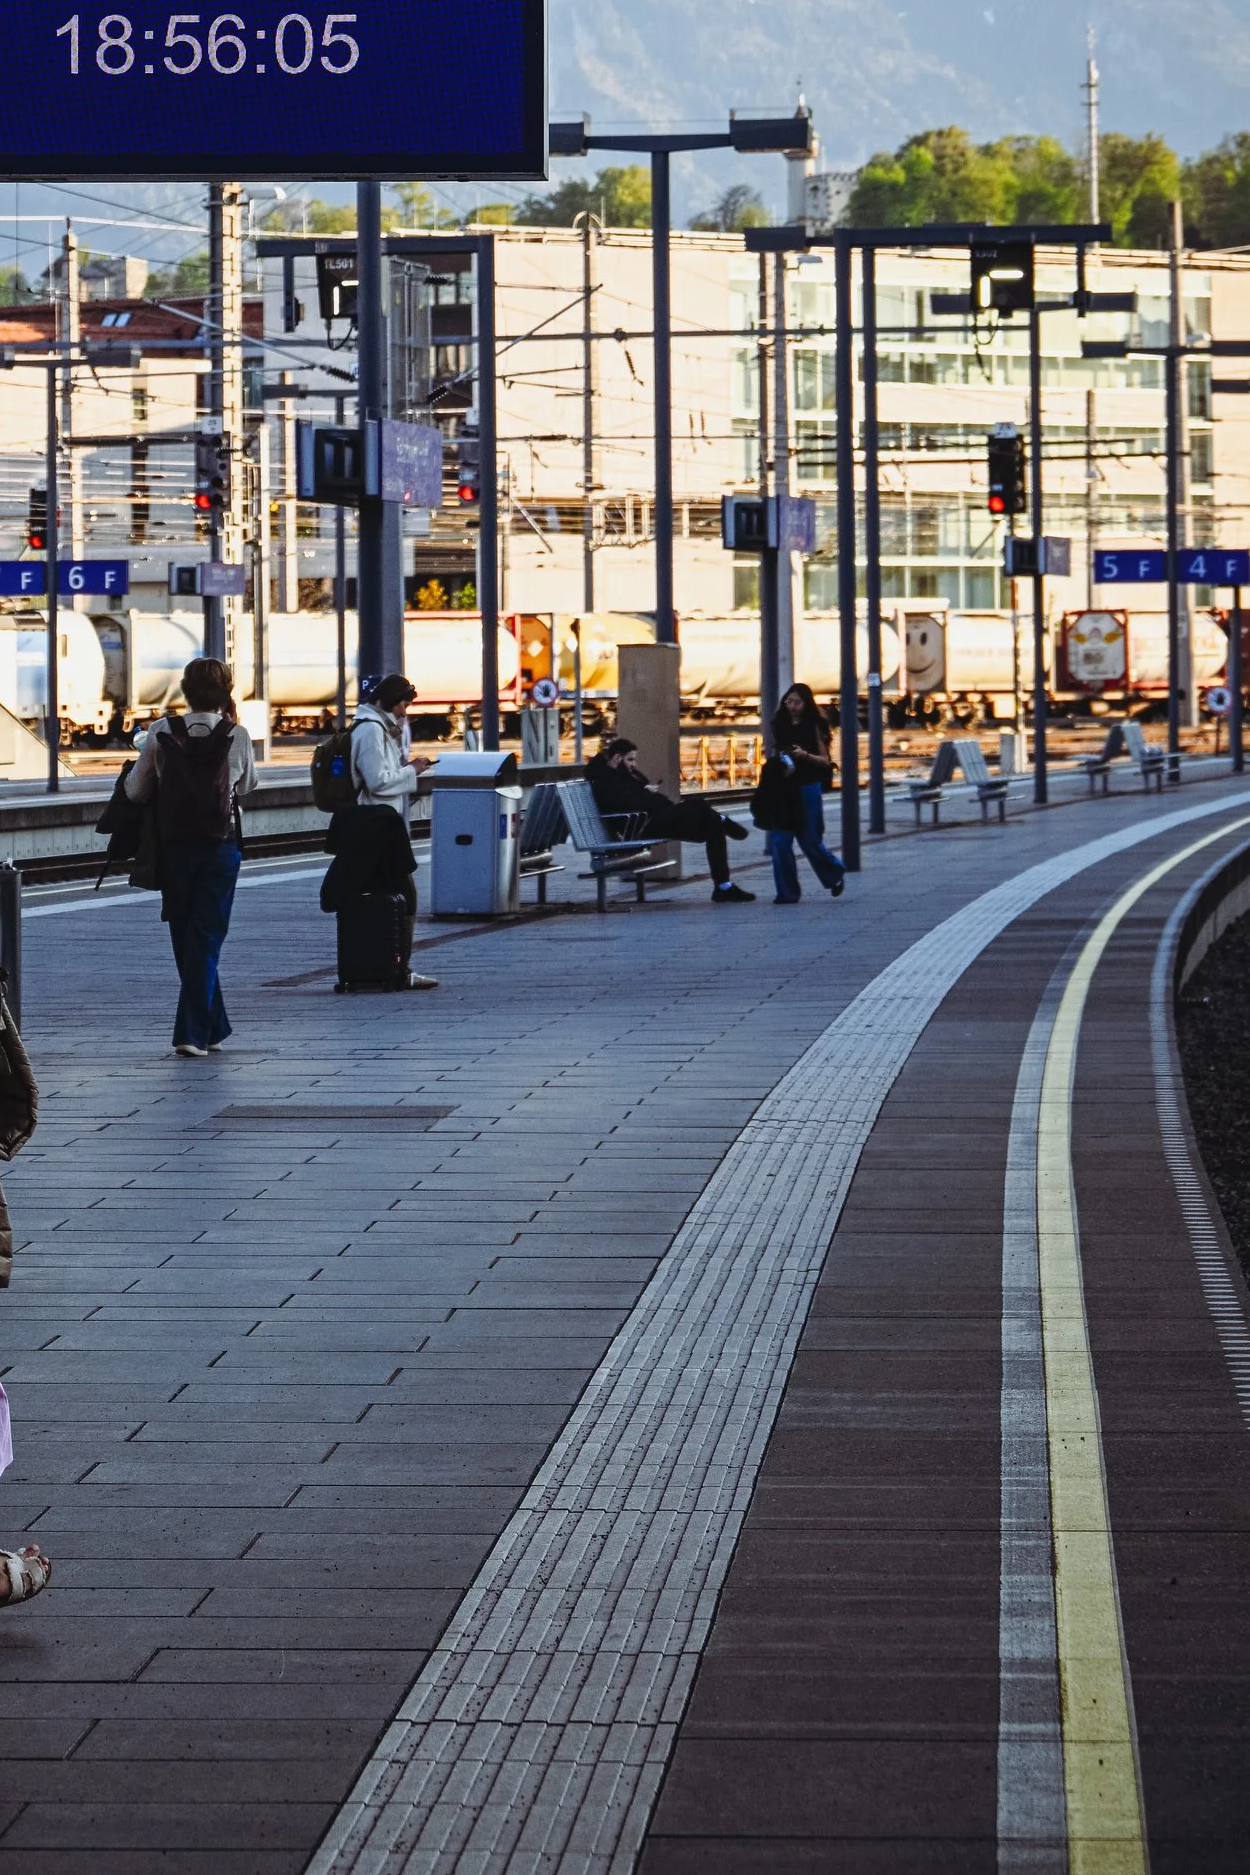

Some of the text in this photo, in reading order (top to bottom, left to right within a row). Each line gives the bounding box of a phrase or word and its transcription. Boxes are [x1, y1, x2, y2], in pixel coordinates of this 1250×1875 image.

[55, 12, 360, 76] 18:56:05
[68, 566, 116, 590] 6 F
[1103, 555, 1150, 578] 5 F
[1189, 555, 1238, 578] 4 F
[21, 572, 32, 590] F
